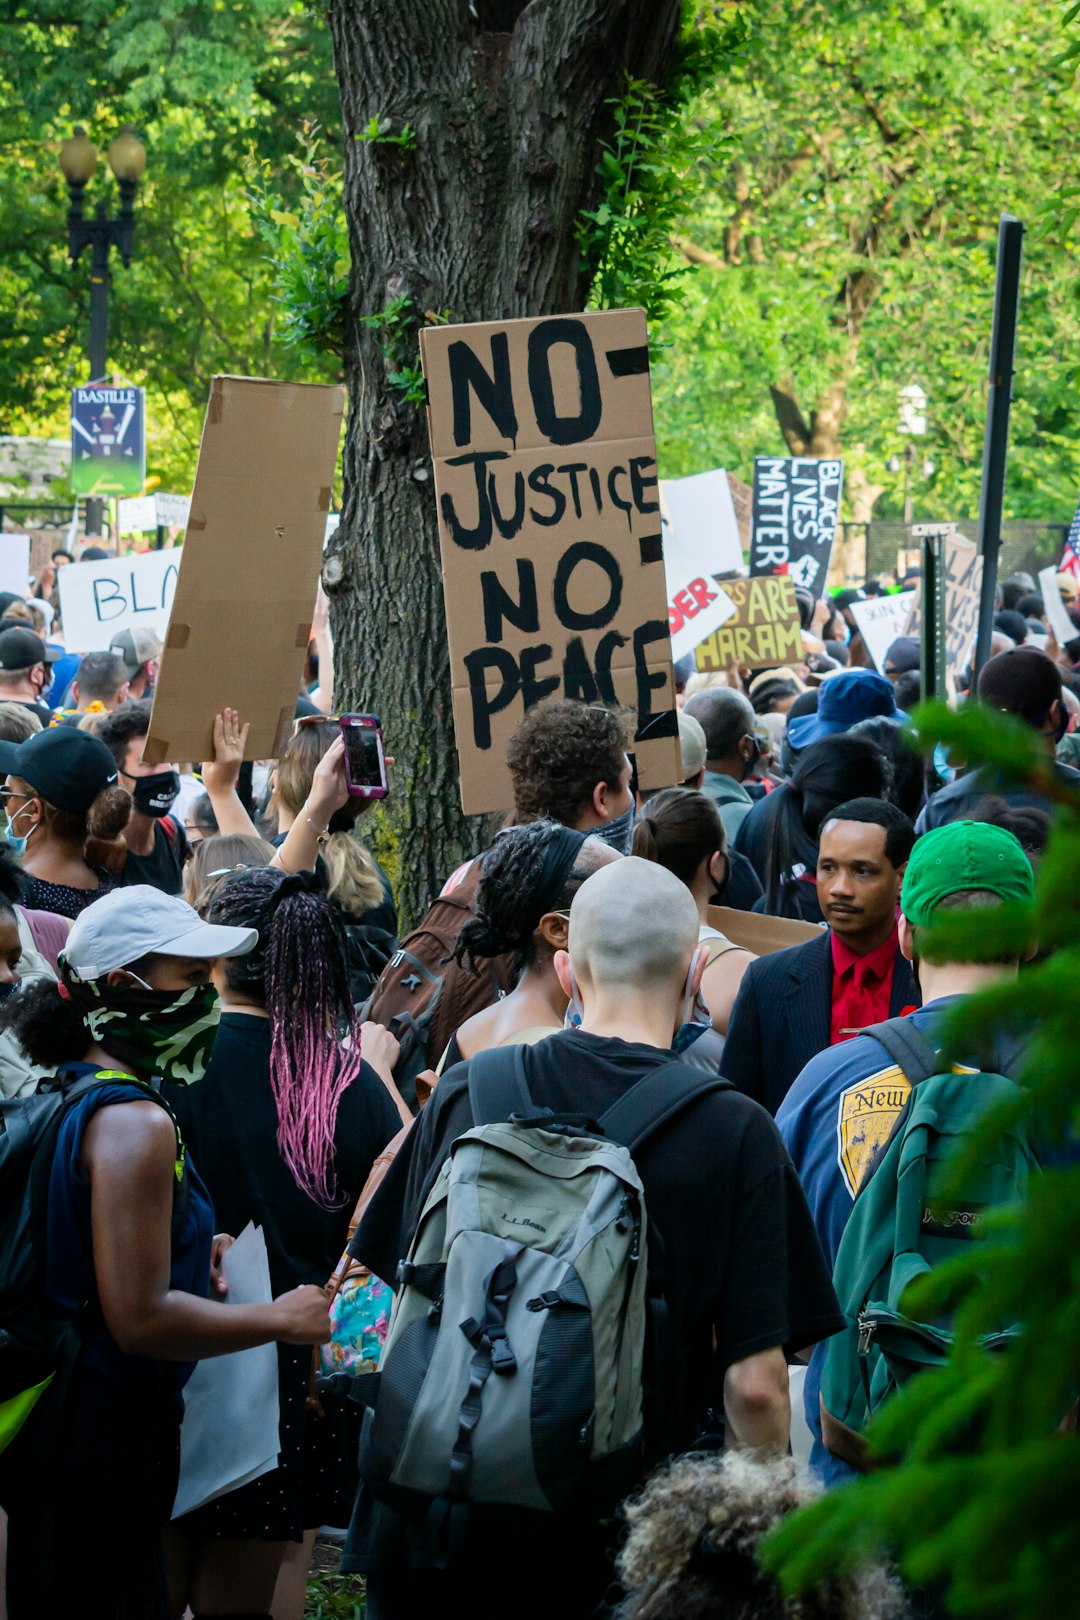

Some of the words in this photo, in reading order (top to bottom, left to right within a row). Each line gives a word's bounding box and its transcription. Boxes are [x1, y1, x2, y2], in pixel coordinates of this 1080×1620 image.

[78, 389, 137, 404] BASTILLE
[448, 318, 603, 449] NO
[440, 450, 660, 551] JUSTICE
[755, 459, 790, 568] MATTER
[791, 459, 819, 540] LIVES
[817, 461, 840, 544] BLACK
[480, 541, 623, 643] NO
[747, 575, 799, 614] ARE
[463, 619, 671, 750] PEACE
[696, 620, 804, 670] HARAM
[922, 1207, 985, 1228] JASPORT
